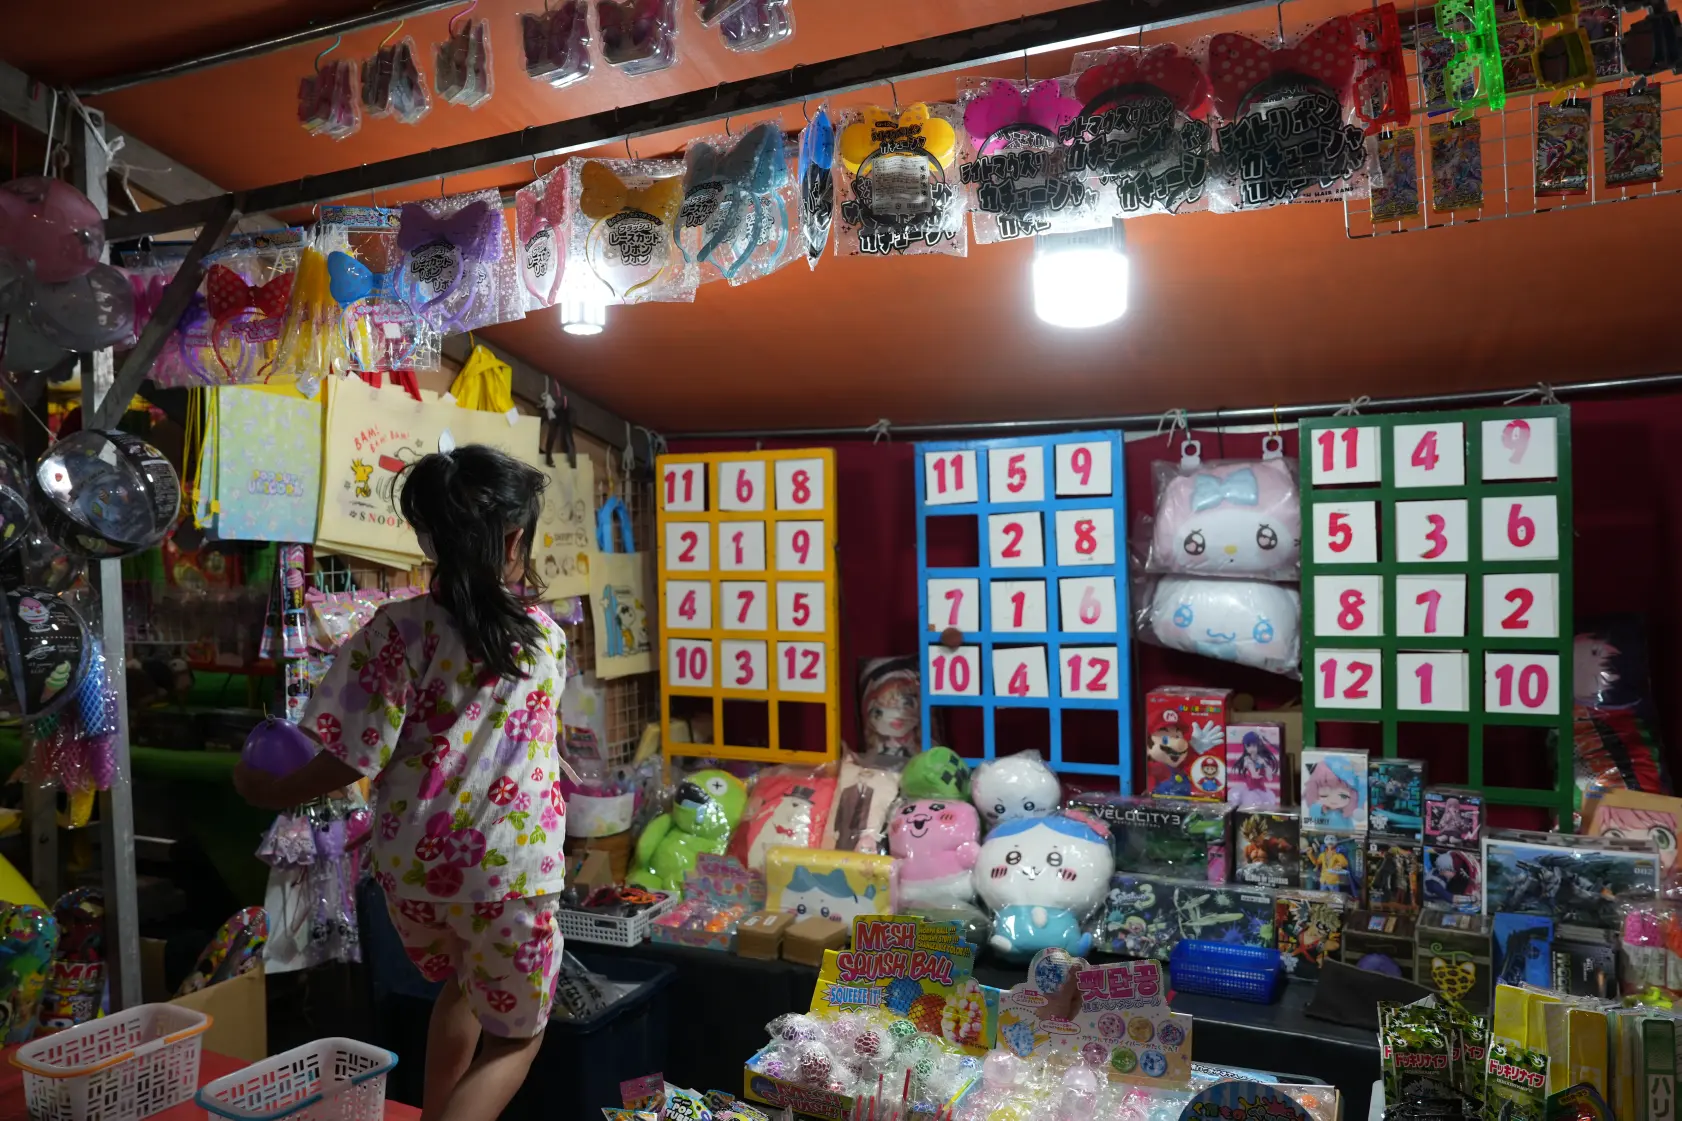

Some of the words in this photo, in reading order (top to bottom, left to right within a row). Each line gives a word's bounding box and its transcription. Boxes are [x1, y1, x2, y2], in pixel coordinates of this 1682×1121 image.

[978, 179, 1085, 213] カチューシャ
[609, 232, 659, 246] レースカット
[618, 222, 652, 234] フラッシュ
[621, 244, 652, 257] リボン
[1317, 427, 1360, 473] 11
[1410, 431, 1440, 472] 4
[1500, 417, 1532, 466] 9
[665, 468, 694, 505] 11
[735, 468, 754, 504] 6
[791, 469, 812, 505] 8
[932, 453, 965, 495] 11
[1006, 453, 1028, 494] 5
[1070, 447, 1093, 487] 9
[678, 530, 699, 563] 2
[729, 530, 744, 565] 1
[791, 528, 812, 565] 9
[1000, 521, 1025, 559] 2
[1073, 519, 1098, 555] 8
[1327, 511, 1354, 553] 5
[1419, 513, 1449, 560] 3
[1507, 503, 1537, 548] 6
[677, 590, 697, 621] 4
[736, 590, 755, 624] 7
[792, 592, 811, 628] 5
[944, 588, 965, 626] 7
[1010, 591, 1026, 629] 1
[1079, 584, 1103, 626] 6
[1336, 588, 1367, 632] 8
[1415, 589, 1443, 634] 7
[1500, 587, 1535, 630] 2
[675, 646, 708, 681] 10
[735, 649, 756, 686] 3
[783, 645, 821, 681] 12
[931, 654, 971, 693] 10
[1007, 662, 1031, 697] 4
[1067, 654, 1111, 693] 12
[1319, 657, 1374, 700] 12
[1415, 663, 1434, 705] 1
[1494, 663, 1550, 709] 10
[855, 921, 916, 951] MESH
[837, 951, 908, 982] SQUISH
[909, 951, 954, 986] BALL
[830, 986, 869, 1005] SQUEEZE
[869, 988, 882, 1005] IT!
[1395, 1052, 1448, 1069] ドッキリナイフ
[1489, 1058, 1546, 1088] ドッキリナイフ
[671, 1102, 694, 1117] POP
